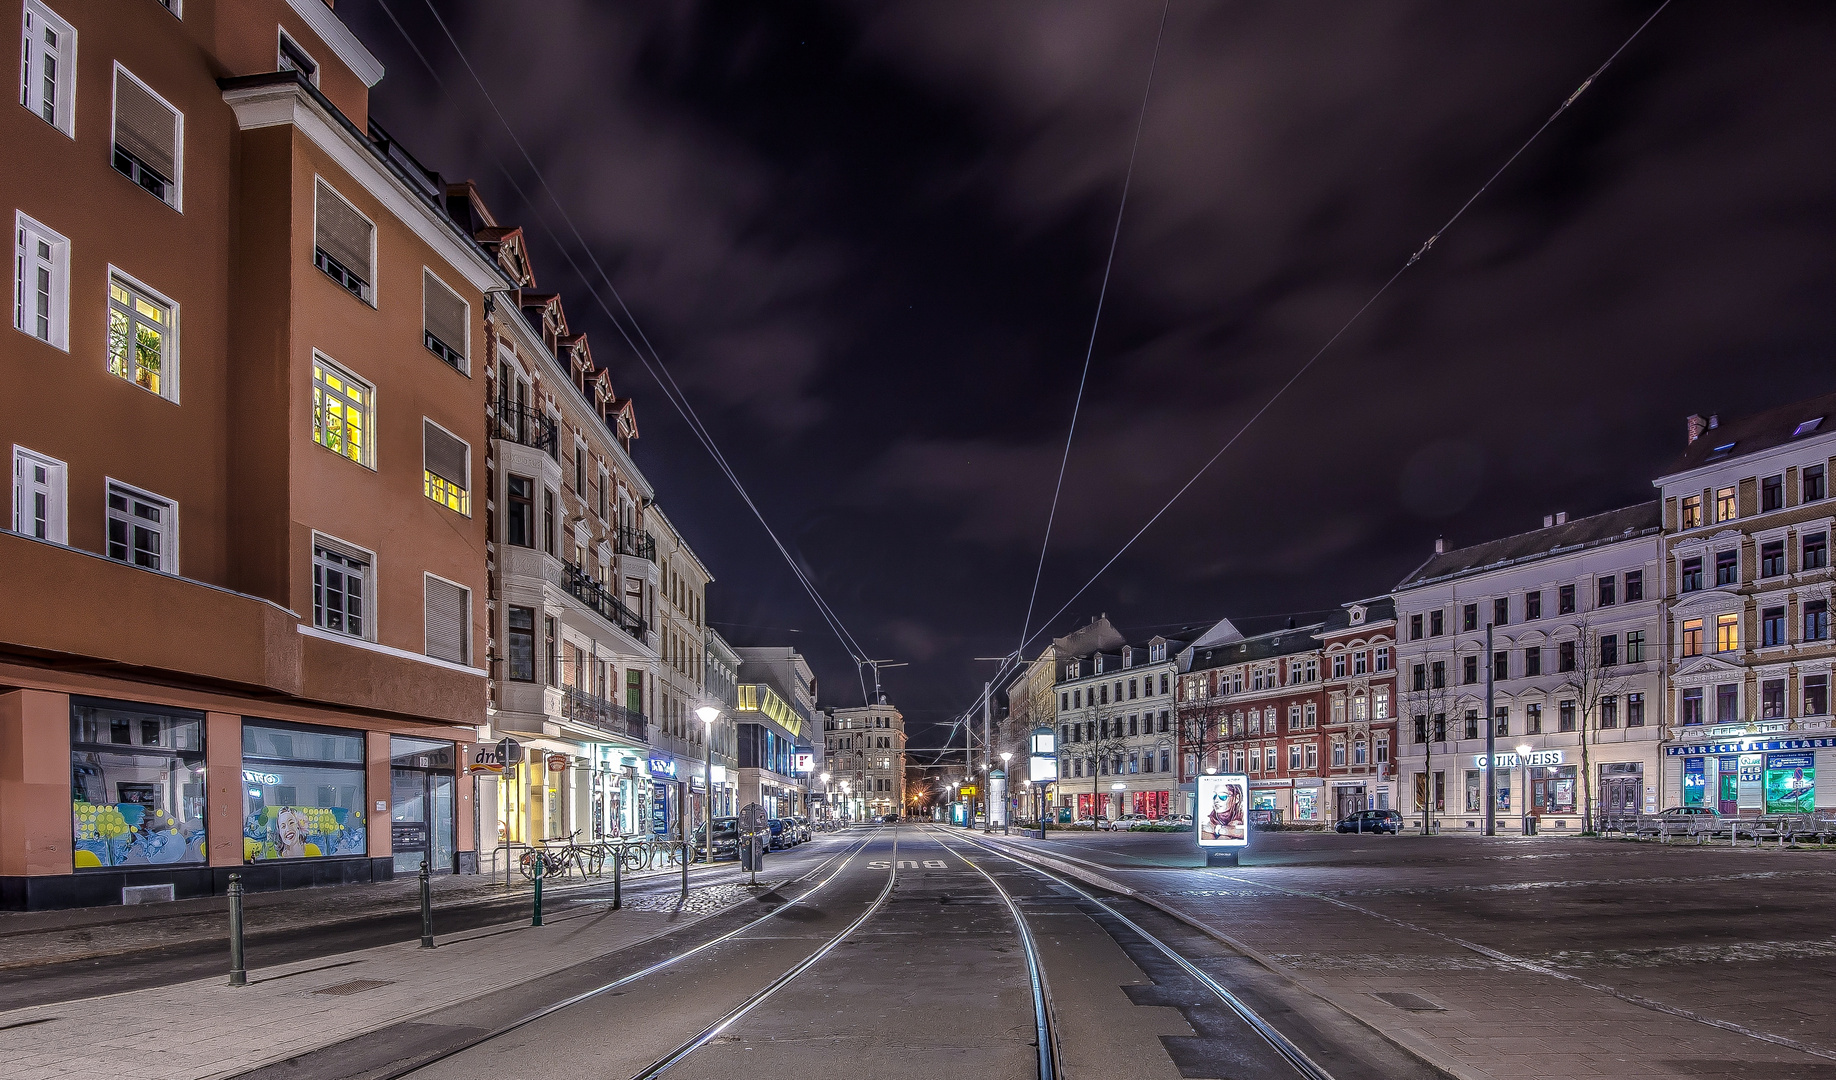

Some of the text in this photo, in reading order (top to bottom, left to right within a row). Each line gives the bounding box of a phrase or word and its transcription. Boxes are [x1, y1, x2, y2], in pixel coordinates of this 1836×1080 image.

[1780, 739, 1833, 750] KLARE
[1479, 753, 1559, 767] OTIK WEISS
[866, 860, 949, 870] BUS
